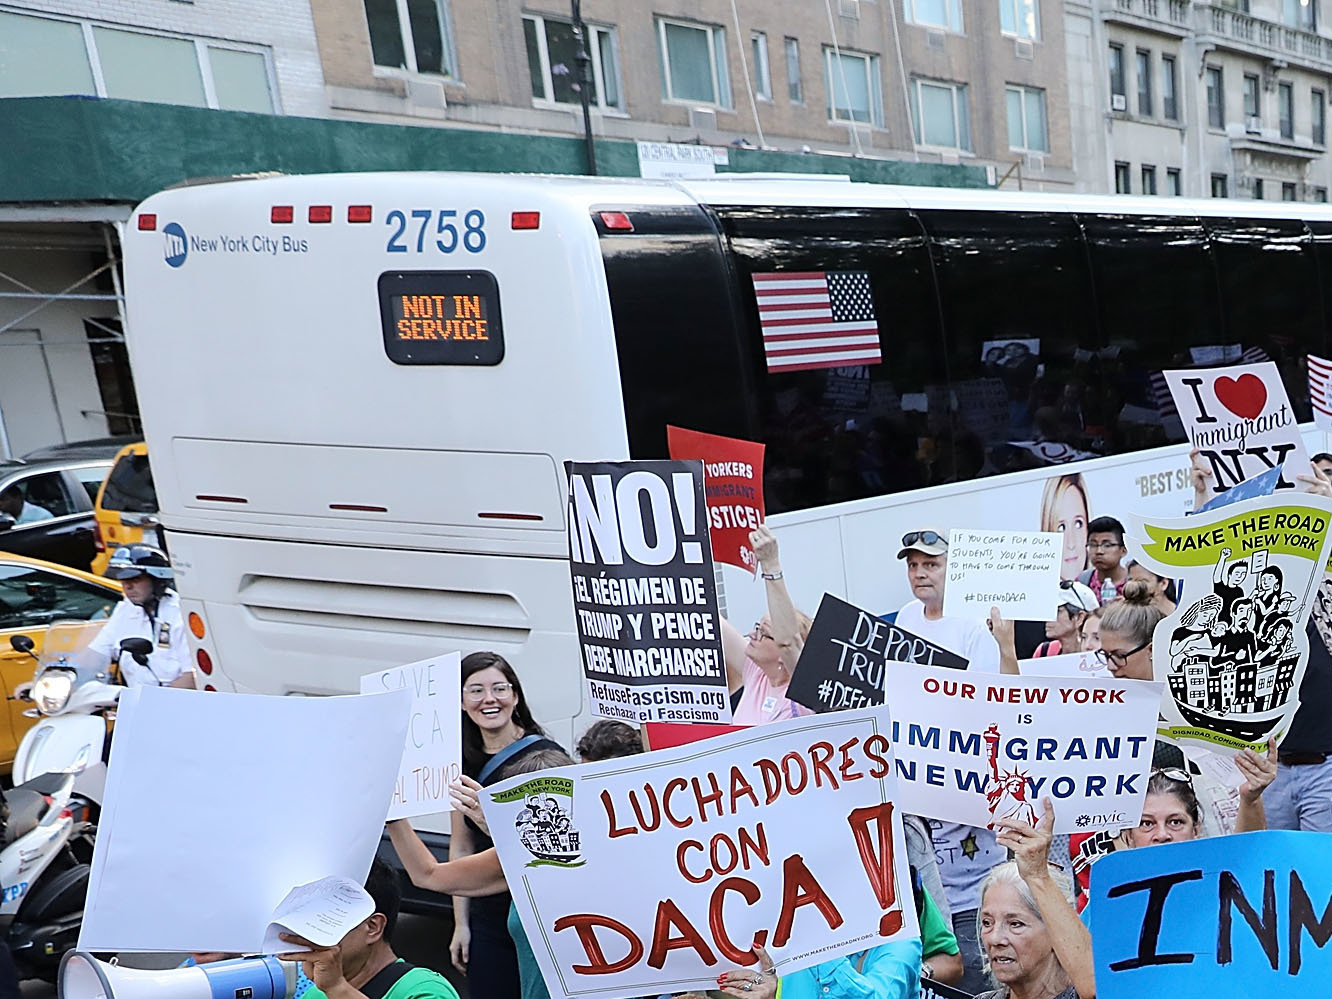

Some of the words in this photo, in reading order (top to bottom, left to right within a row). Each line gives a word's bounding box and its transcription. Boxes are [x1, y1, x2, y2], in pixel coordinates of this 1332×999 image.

[191, 235, 217, 252] New
[220, 235, 249, 252] York
[252, 235, 278, 255] City
[282, 235, 308, 252] Bus
[386, 209, 486, 253] 2758
[402, 295, 445, 318] NOT
[453, 295, 481, 318] IN
[397, 319, 489, 340] SERVICE
[1181, 377, 1217, 424] I
[1191, 404, 1292, 451] Immigrant
[706, 461, 753, 479] YORKERS
[706, 504, 761, 531] STICE!
[954, 534, 963, 543] IF
[968, 534, 981, 543] YOU
[983, 535, 1005, 544] COME
[1012, 535, 1028, 545] FOR
[1032, 537, 1051, 546] OUR
[1164, 528, 1226, 552] MAKE
[1228, 515, 1270, 539] THE
[1273, 513, 1326, 533] ROAD
[1241, 533, 1281, 551] NEW
[1283, 534, 1320, 551] YORK
[950, 561, 959, 569] TO
[962, 562, 980, 570] HAVE
[591, 571, 676, 606] RÉGIMEN
[680, 577, 706, 605] DE
[579, 609, 623, 640] TRUMP
[627, 613, 644, 640] Y
[651, 612, 715, 640] PENCE
[849, 611, 943, 666] DEPORT
[584, 644, 614, 674] DEBE
[612, 647, 721, 678] MARCHARSE!
[831, 638, 886, 691] TRU
[590, 682, 725, 710] RefuseFascism.org
[923, 678, 976, 700] OUR
[987, 686, 1048, 704] NEW
[1059, 688, 1126, 704] YORK
[599, 703, 636, 721] Rechazar
[639, 708, 652, 721] el
[658, 707, 719, 721] Fascismo
[1018, 714, 1033, 725] IS
[892, 721, 1147, 761] IMMIGRANT
[1172, 729, 1211, 739] DIGNIDAD,
[1213, 735, 1255, 750] COMUNIDAD
[412, 762, 460, 801] TRUMP
[500, 788, 525, 799] MAKE
[526, 780, 544, 789] THE
[544, 780, 572, 788] ROAD
[532, 786, 550, 794] NEW
[551, 786, 570, 794] YORK
[598, 733, 891, 838] LUCHADORES
[895, 759, 990, 795] NEW
[1028, 773, 1141, 799] YORK
[1088, 810, 1126, 829] nyic
[676, 822, 770, 883] CON
[792, 933, 873, 961] WWW.MAKETHEROADNY.ORG
